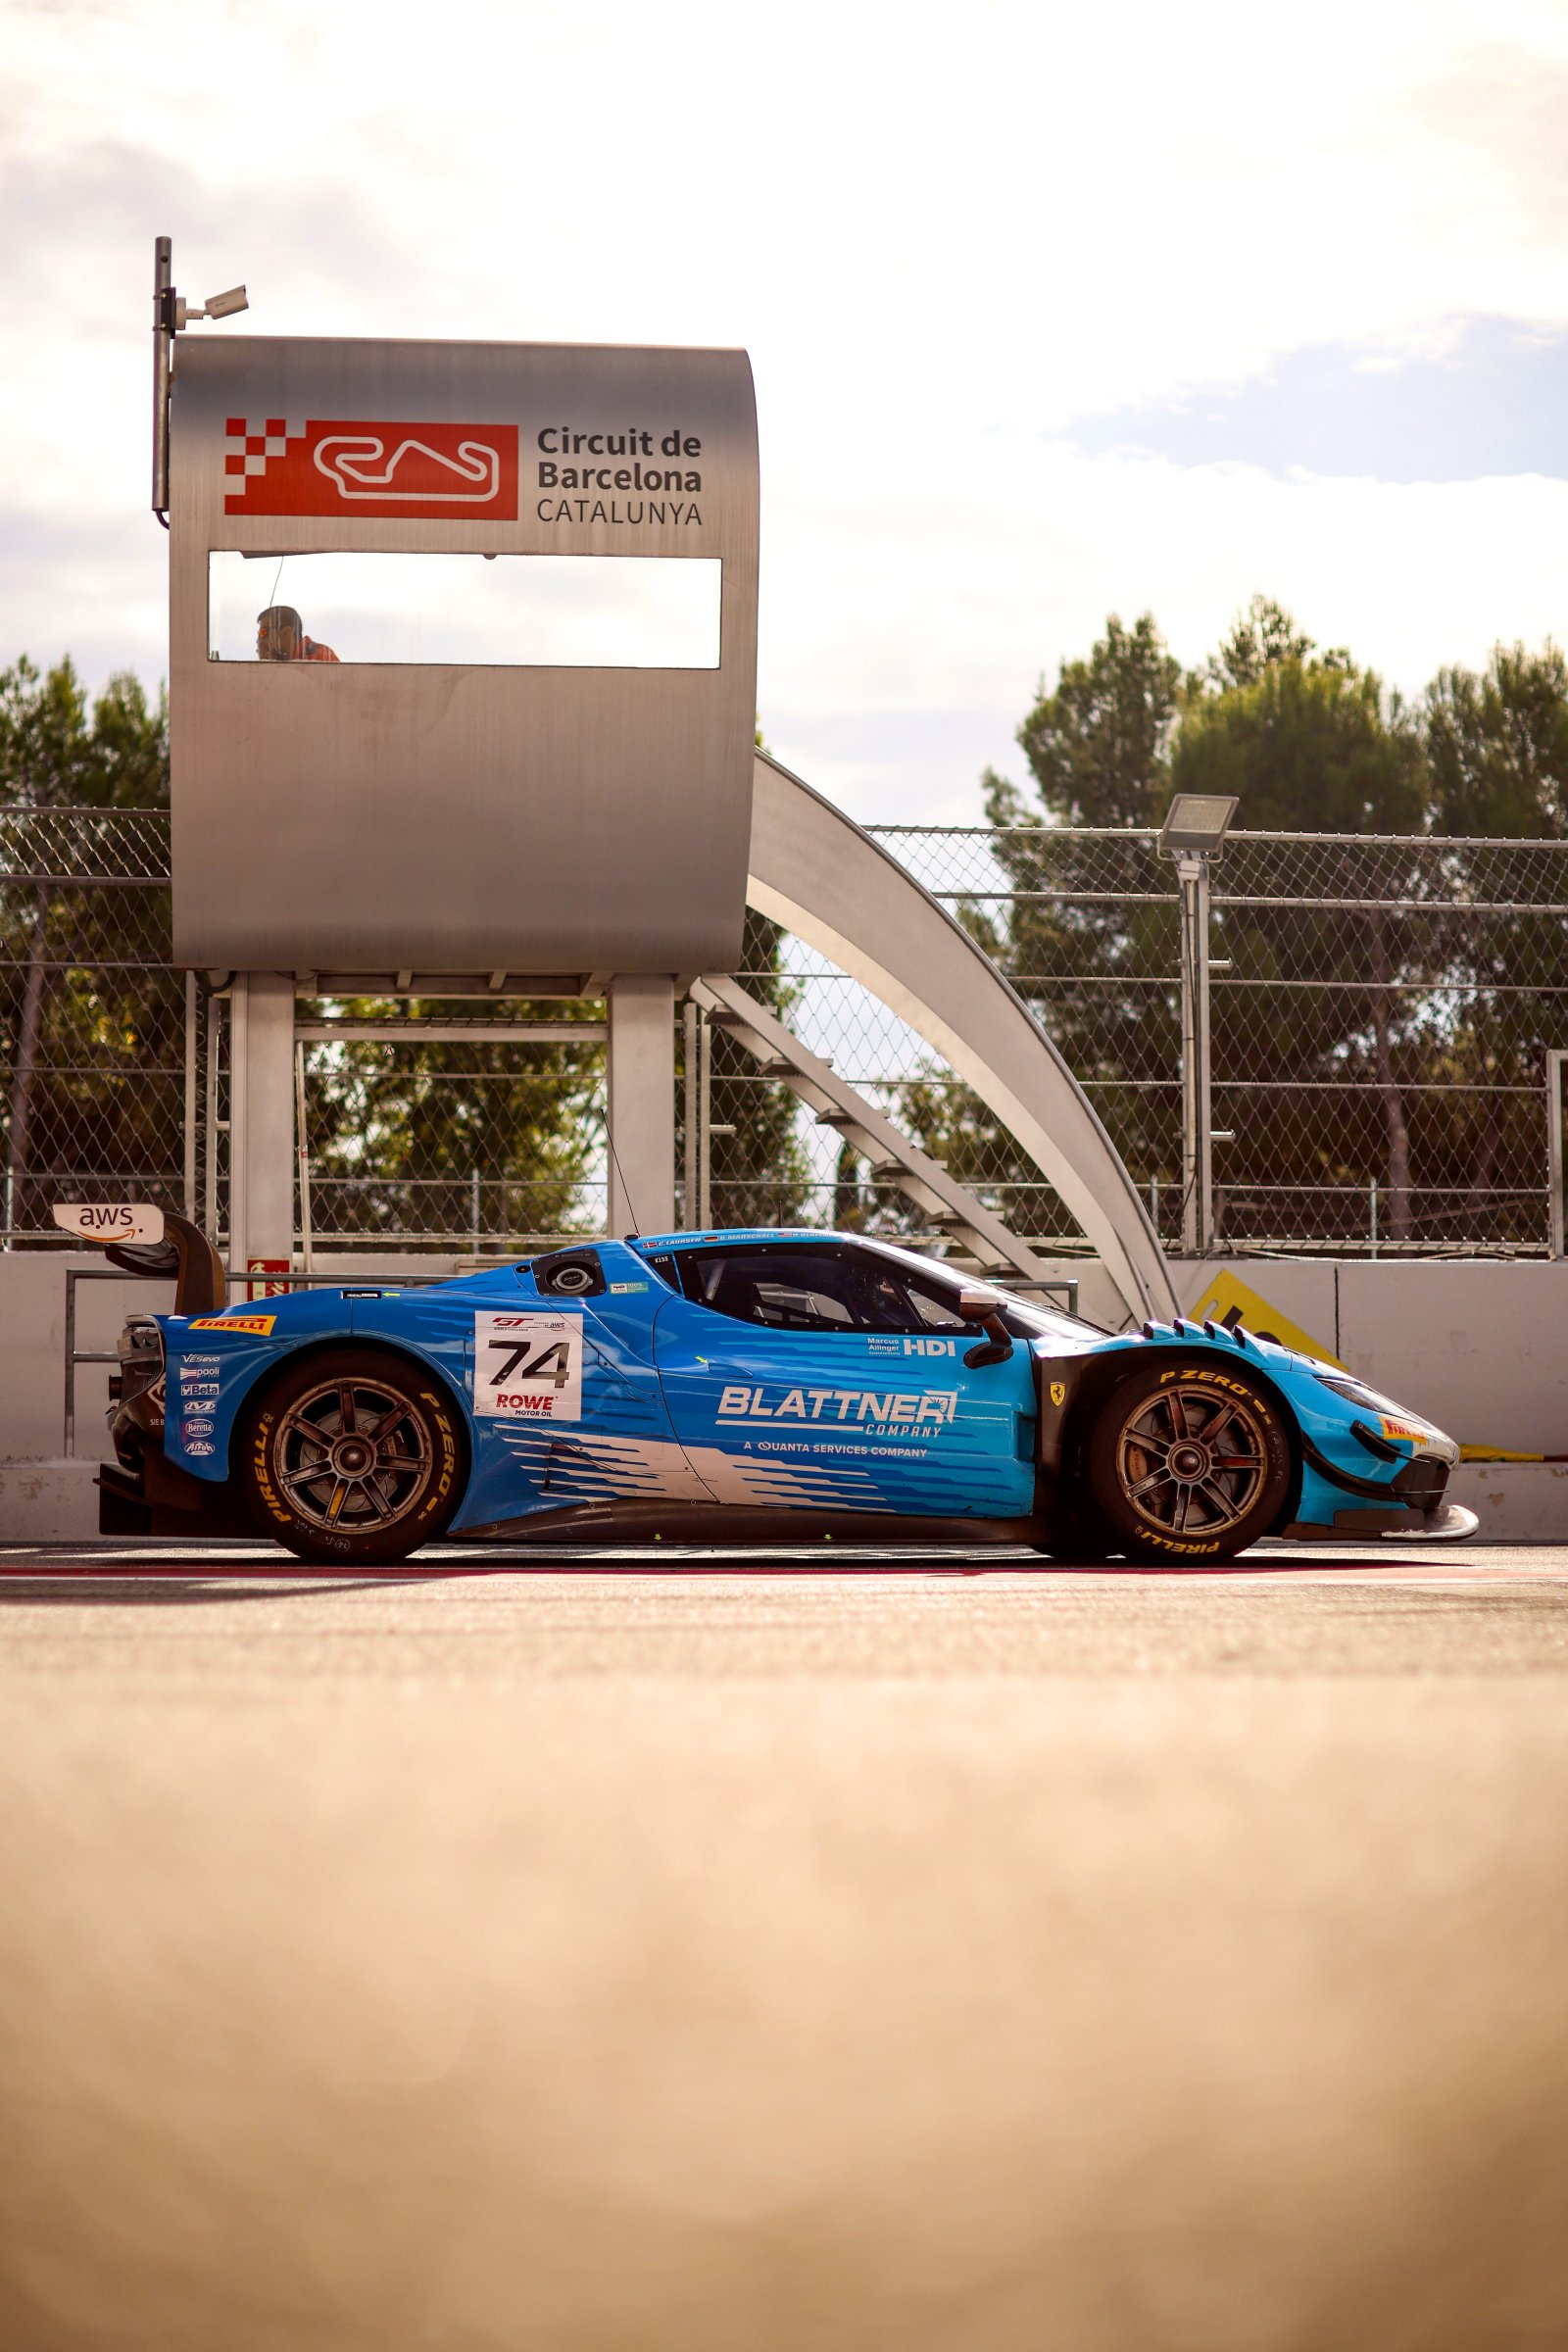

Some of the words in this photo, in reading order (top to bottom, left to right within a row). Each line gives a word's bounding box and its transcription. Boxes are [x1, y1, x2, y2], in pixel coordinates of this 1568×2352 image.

[537, 427, 653, 456] Circuit
[661, 429, 702, 457] de
[538, 462, 702, 492] Barcelona
[537, 498, 703, 525] CATALUNYA
[79, 1206, 133, 1226] aws
[197, 1317, 268, 1330] PIRELLI
[492, 1317, 534, 1326] GT
[903, 1339, 956, 1356] HDI
[488, 1339, 569, 1388] 74
[192, 1385, 218, 1395] Beta
[1159, 1372, 1176, 1384] P
[1180, 1370, 1248, 1396] ZERO
[496, 1393, 554, 1410] ROWE
[717, 1386, 957, 1424] BLATTNER
[188, 1423, 212, 1432] Beretta
[865, 1424, 942, 1438] COMPANY
[419, 1393, 440, 1407] P
[435, 1414, 455, 1498] ZERO
[758, 1441, 809, 1452] QUANTA
[812, 1444, 870, 1455] SERVICES
[871, 1446, 927, 1457] COMPANY
[254, 1423, 292, 1522] PIRELLI
[1140, 1532, 1220, 1554] PIRELLI
